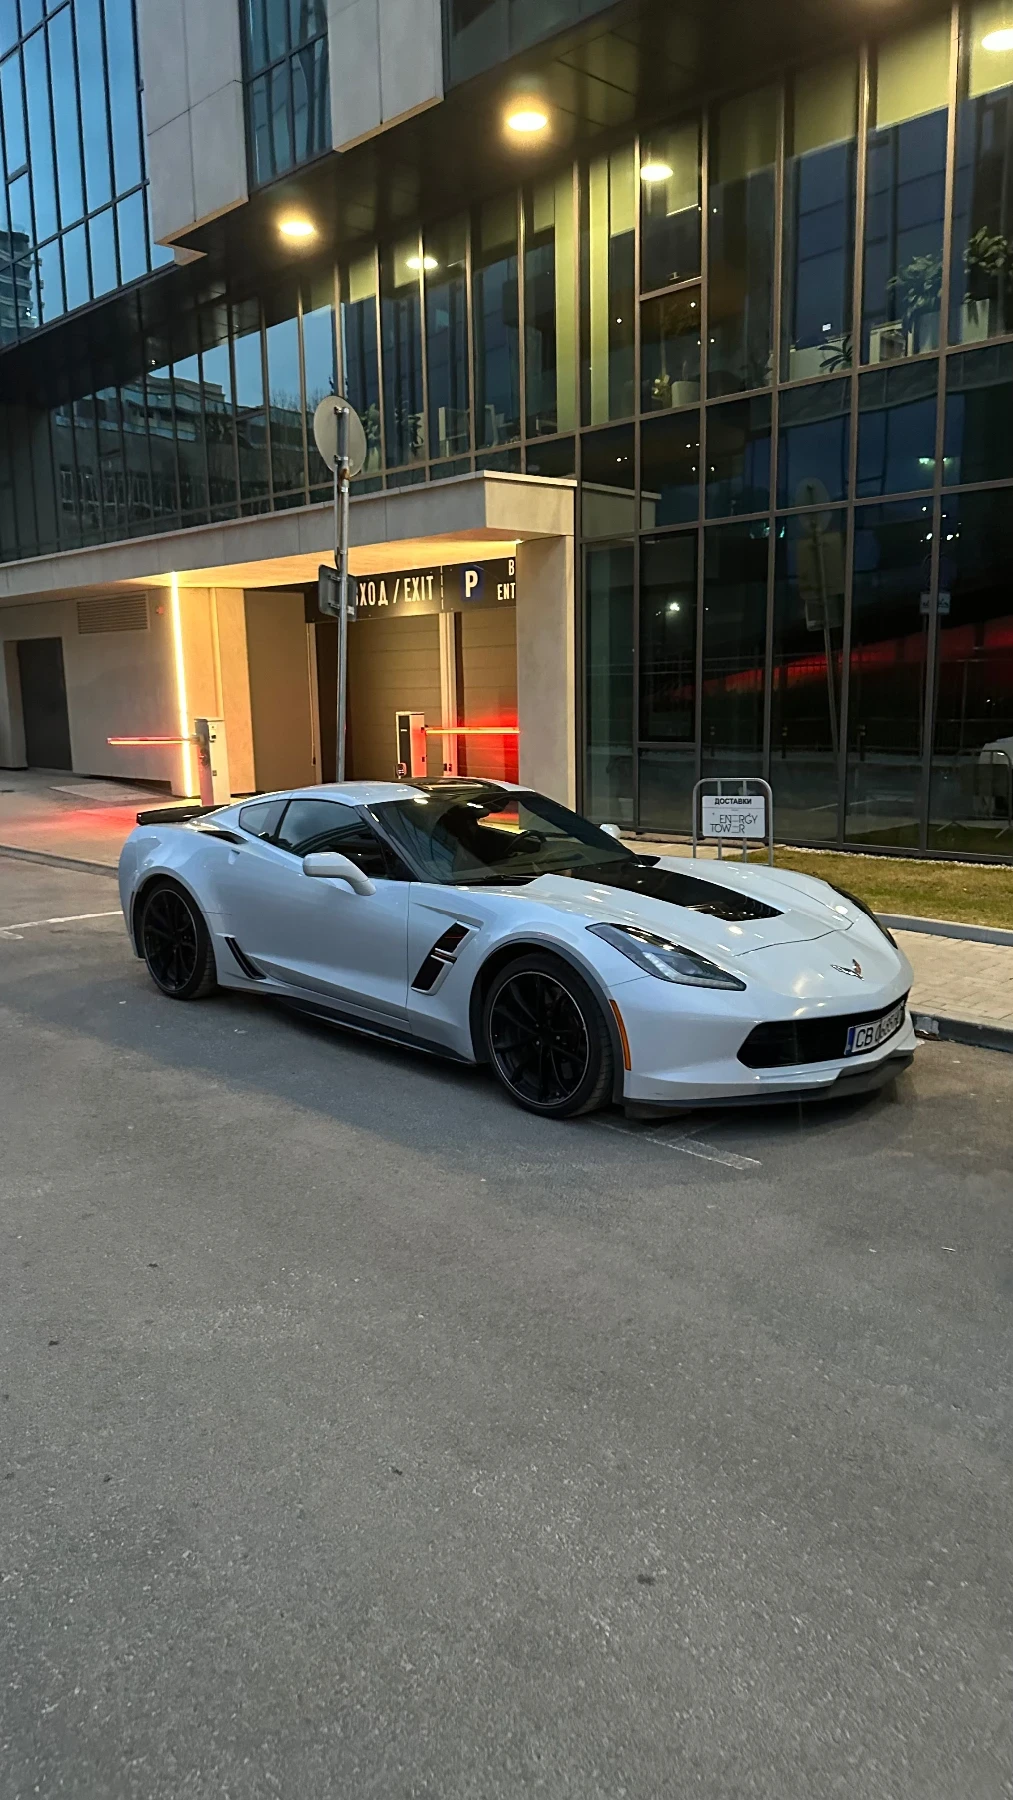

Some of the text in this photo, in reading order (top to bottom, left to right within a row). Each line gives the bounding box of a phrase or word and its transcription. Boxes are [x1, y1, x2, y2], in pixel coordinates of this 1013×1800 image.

[393, 579, 400, 604] /
[404, 575, 434, 602] EXIT
[464, 570, 479, 597] P
[497, 583, 516, 601] ENT
[719, 813, 758, 825] ENERGY
[710, 824, 745, 834] TOWER
[856, 1027, 873, 1047] CB
